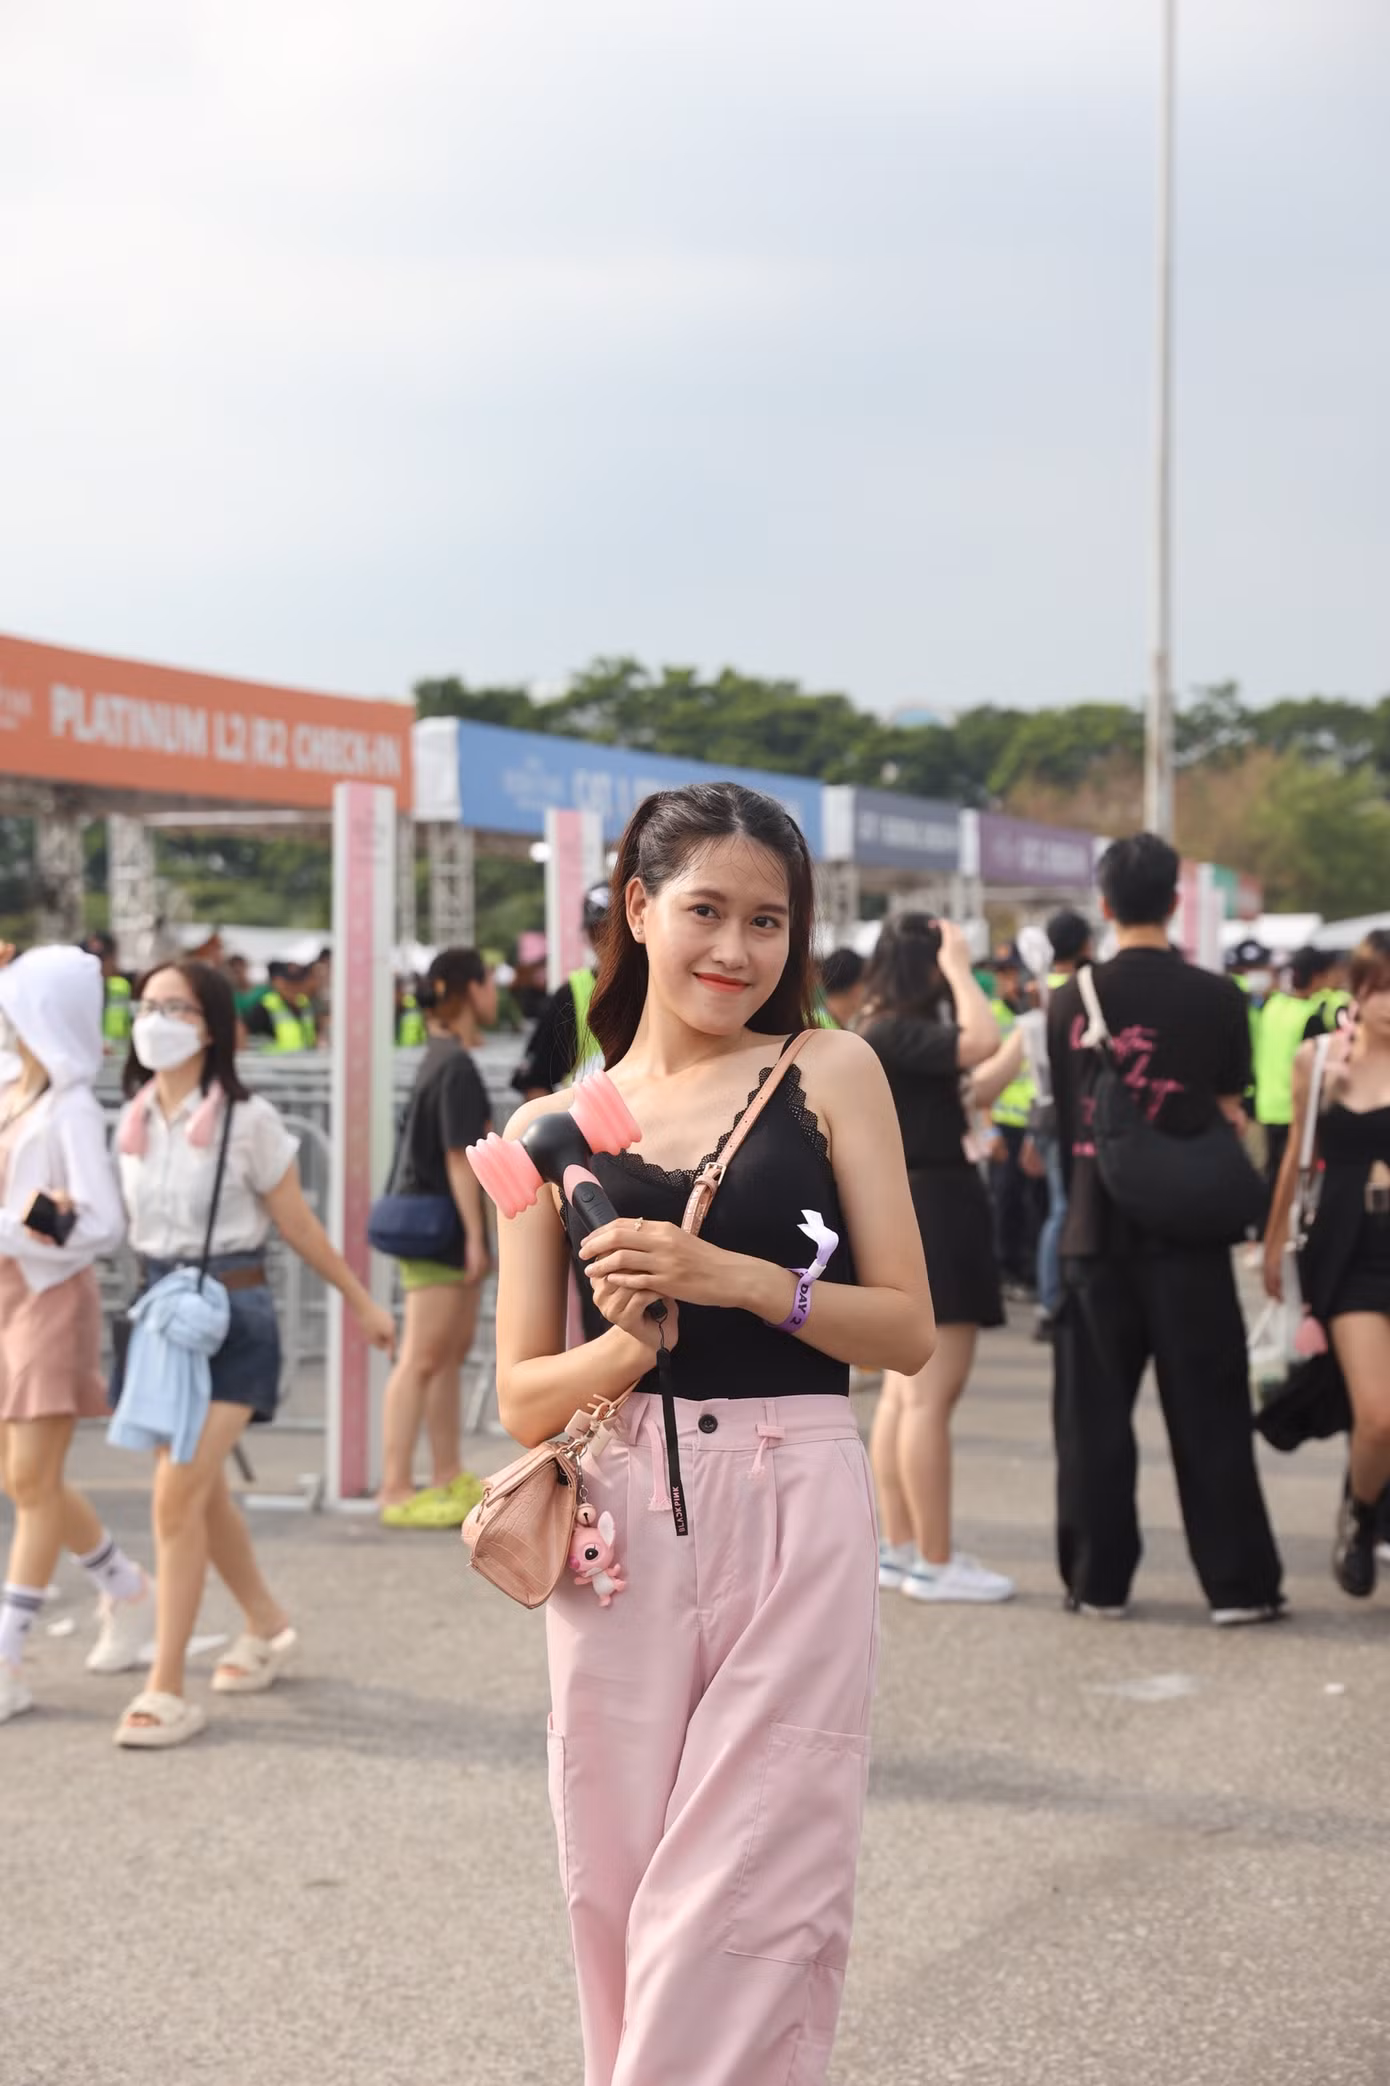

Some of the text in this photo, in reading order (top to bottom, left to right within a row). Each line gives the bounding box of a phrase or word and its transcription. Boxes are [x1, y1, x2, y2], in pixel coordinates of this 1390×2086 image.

[50, 683, 207, 757] PLATINUM
[293, 721, 402, 777] CHECK-IN
[798, 1283, 809, 1314] DAY
